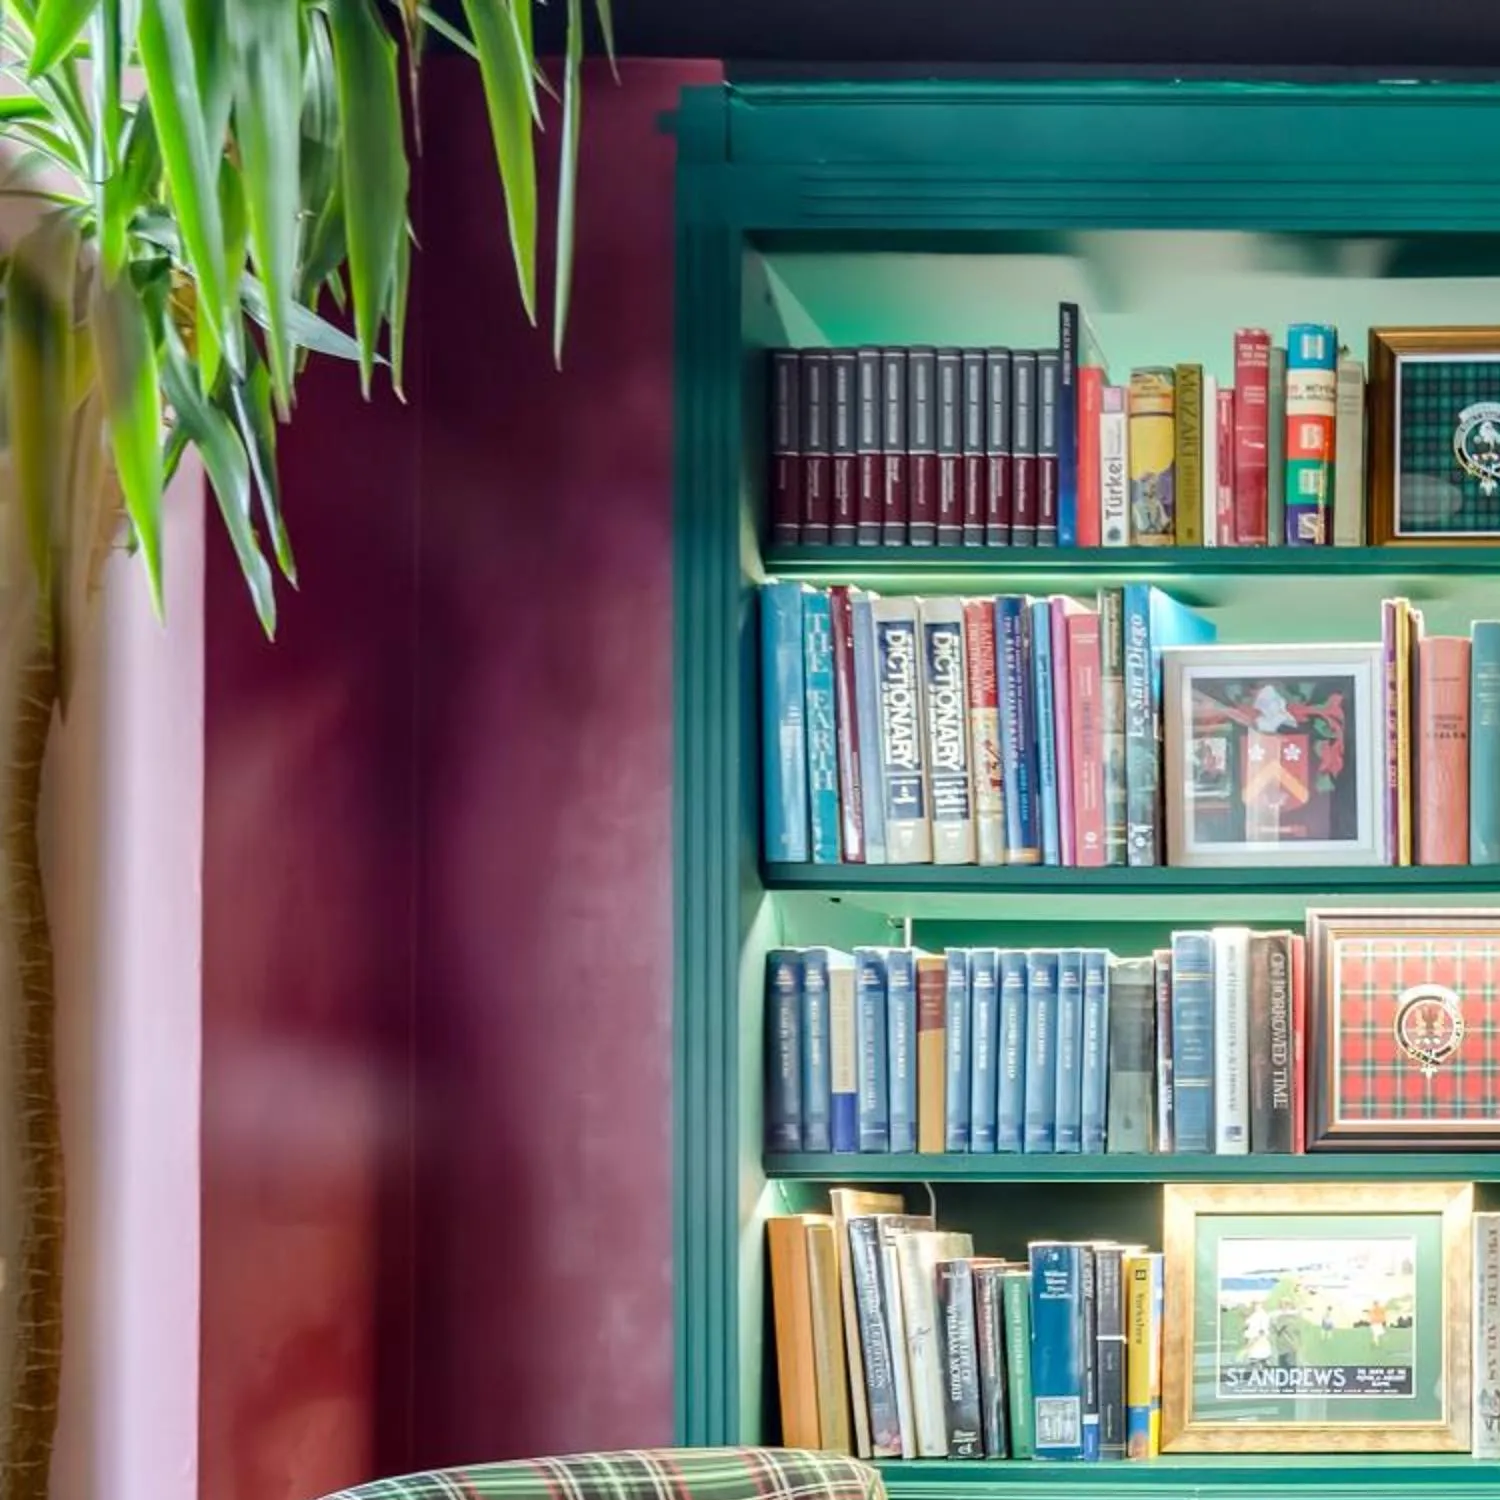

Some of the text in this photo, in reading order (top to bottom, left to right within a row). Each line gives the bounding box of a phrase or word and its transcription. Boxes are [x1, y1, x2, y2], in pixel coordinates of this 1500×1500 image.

[1180, 369, 1199, 458] MOZART
[1104, 456, 1125, 521] Türkei
[886, 630, 915, 769] DICTIONARY
[933, 631, 961, 770] DICTIONARY
[1126, 613, 1146, 738] Le San Diego
[1271, 952, 1288, 1109] ON BORROWED TIME
[946, 1305, 962, 1401] WILLIAM MORRIS
[1247, 1368, 1347, 1387] ANDREWS
